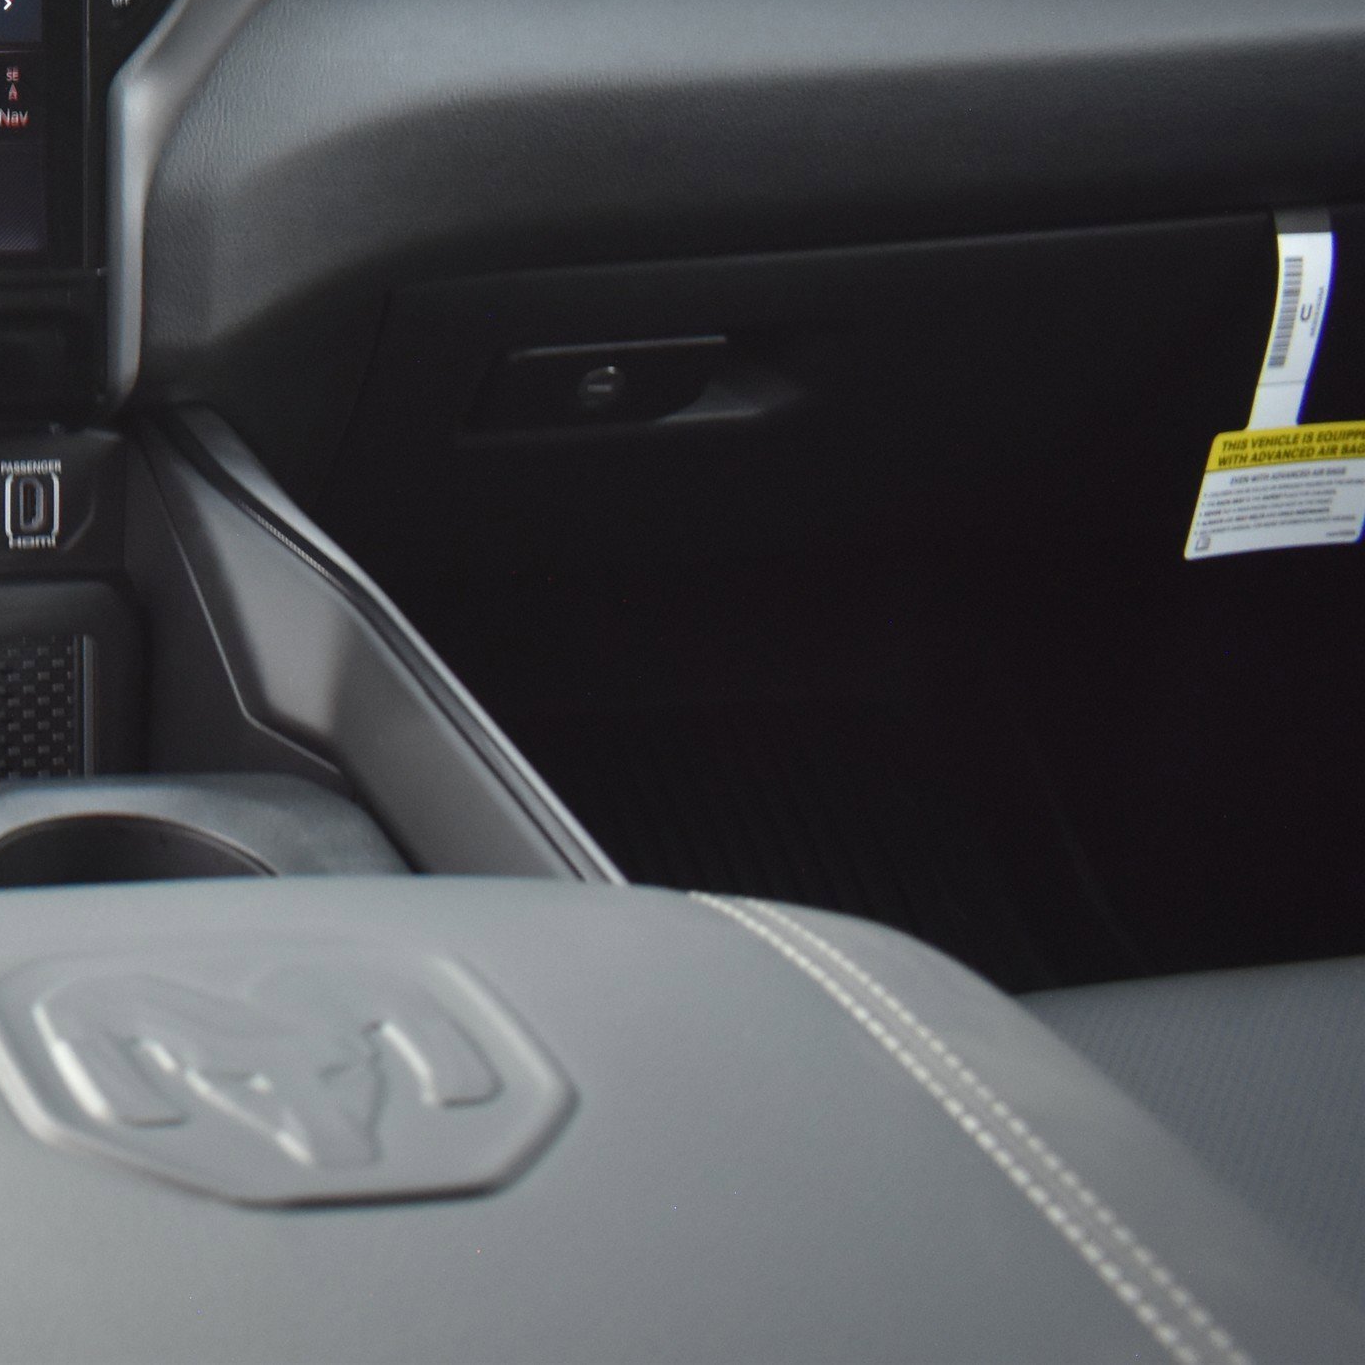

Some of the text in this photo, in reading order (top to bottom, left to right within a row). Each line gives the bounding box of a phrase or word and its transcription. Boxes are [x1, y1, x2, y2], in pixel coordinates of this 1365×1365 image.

[1221, 438, 1248, 452] THIS
[1251, 433, 1300, 448] VEHICLE
[1218, 453, 1249, 467] WITH
[1249, 447, 1315, 466] ADVANCED
